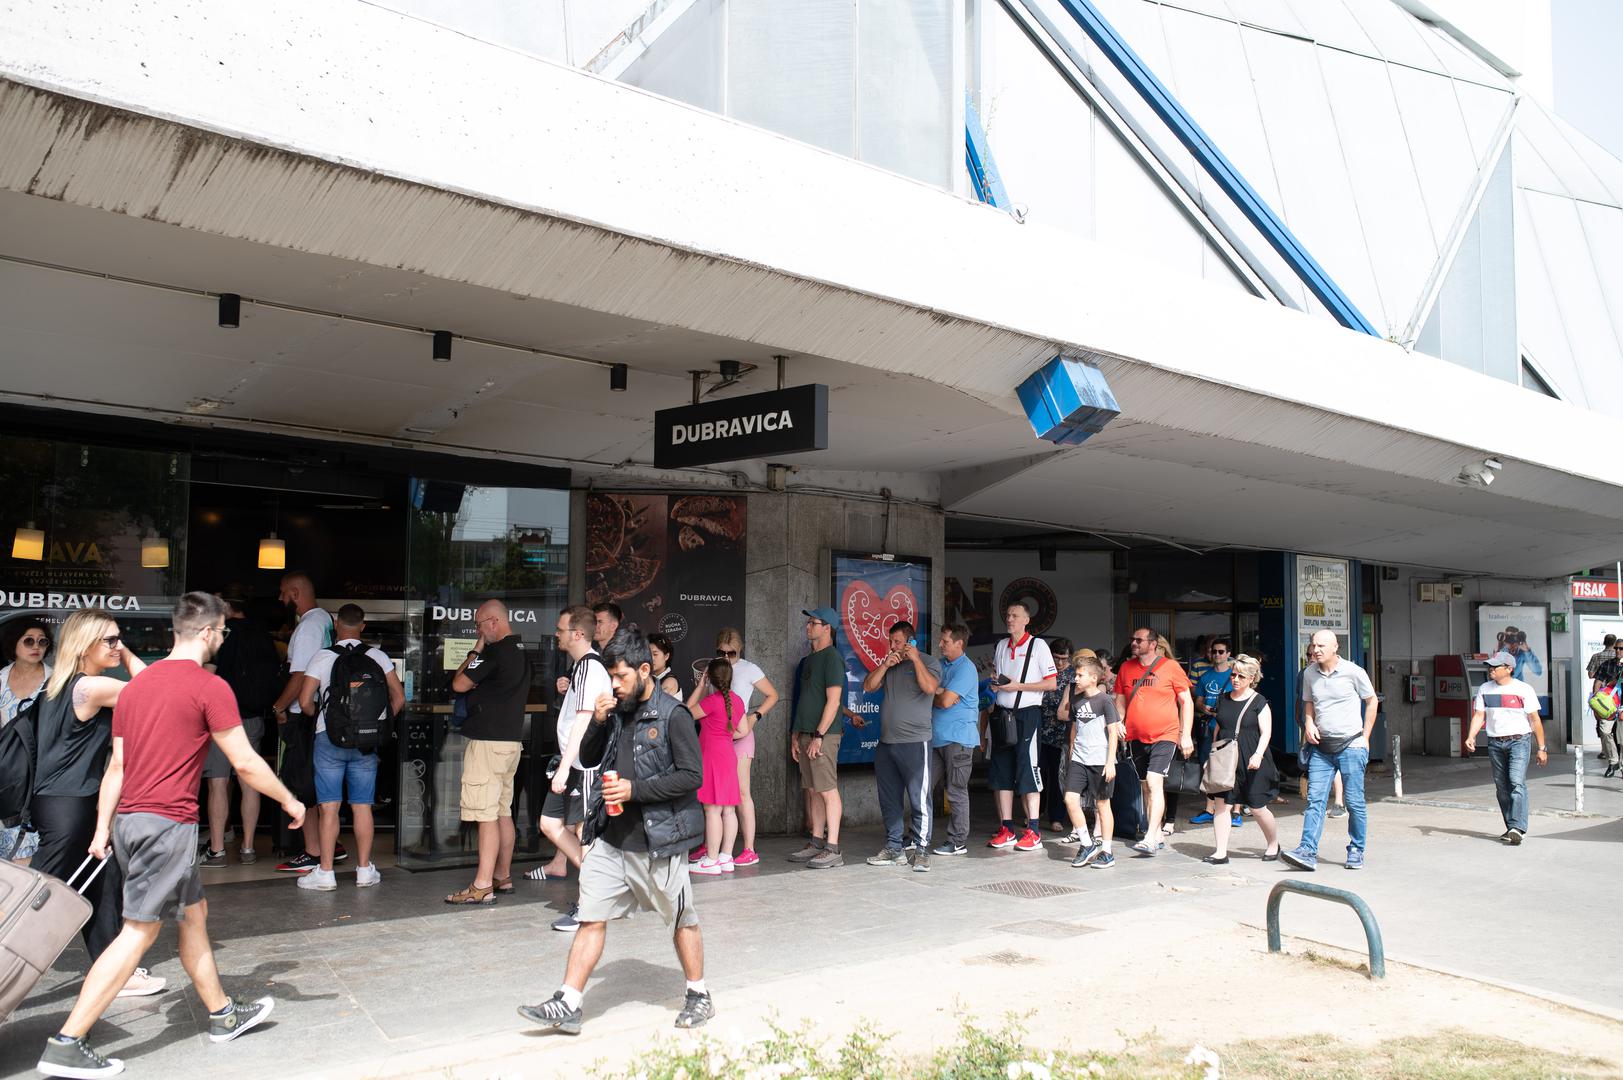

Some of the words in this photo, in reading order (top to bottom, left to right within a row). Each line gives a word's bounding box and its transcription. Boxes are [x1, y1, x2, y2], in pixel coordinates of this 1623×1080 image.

[671, 410, 793, 445] DUBRAVICA
[1572, 582, 1607, 597] TISAK
[680, 594, 733, 602] DUBRAVICA
[432, 605, 537, 623] DUBICA
[850, 702, 880, 713] Budite
